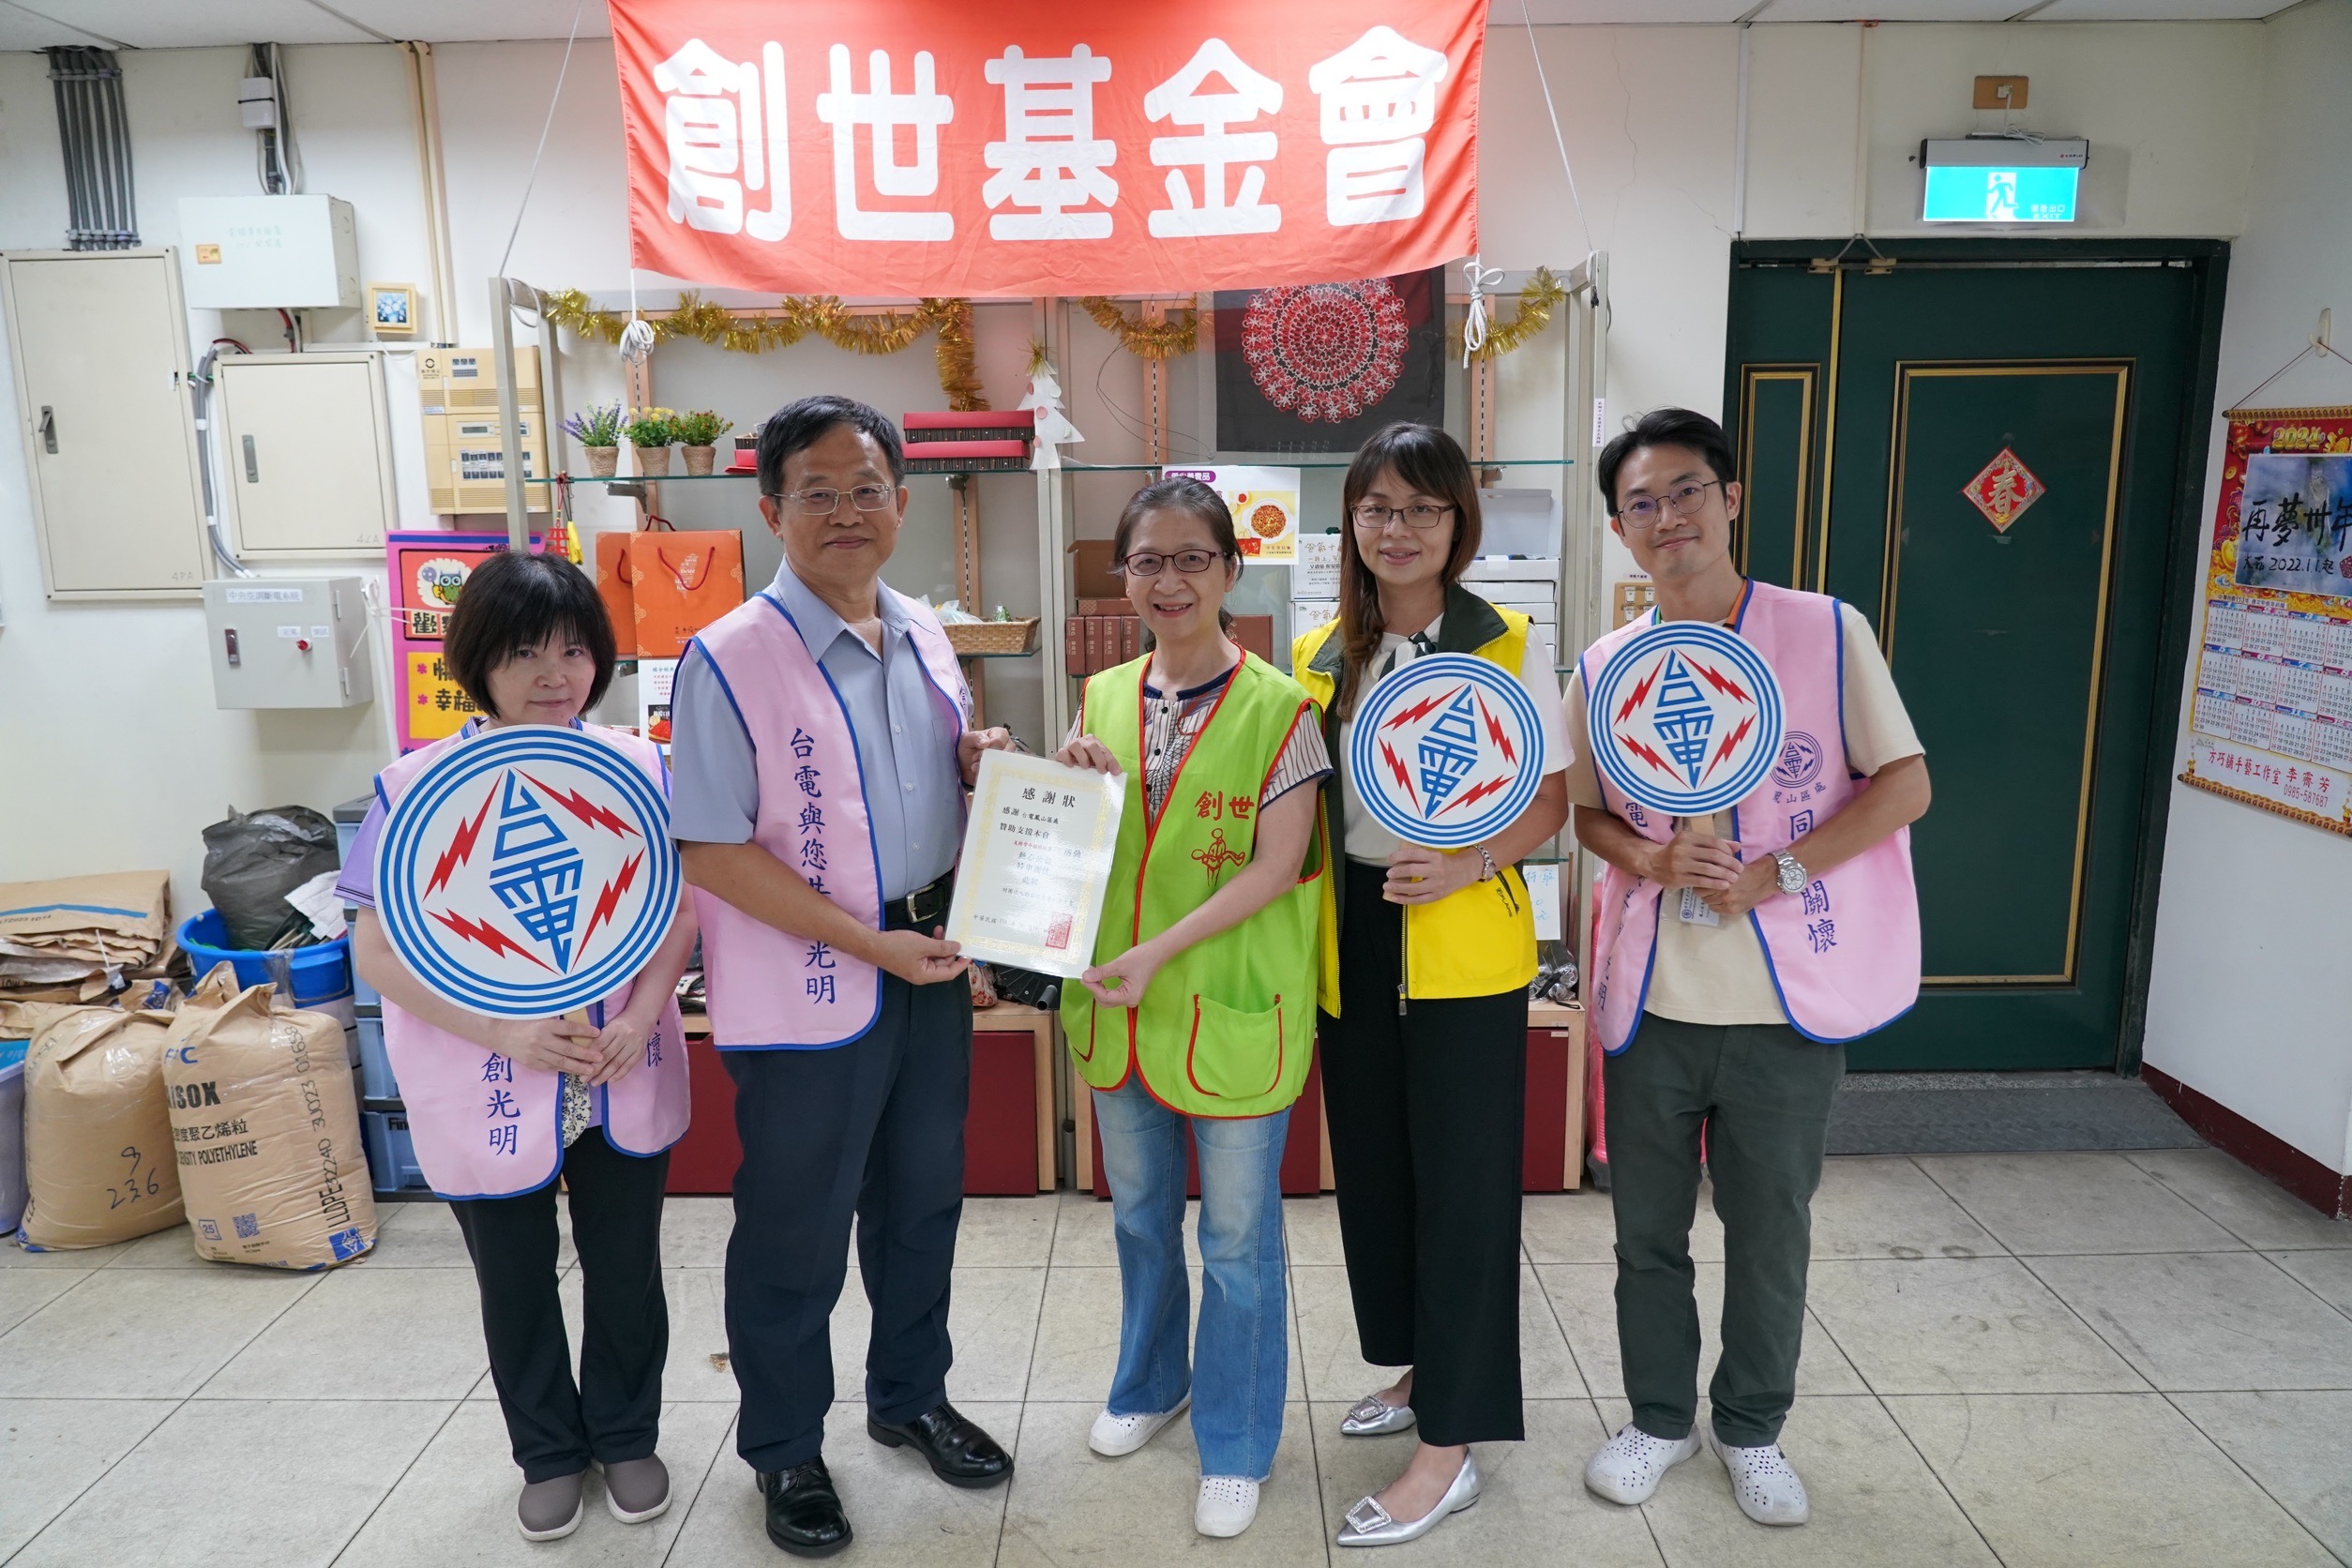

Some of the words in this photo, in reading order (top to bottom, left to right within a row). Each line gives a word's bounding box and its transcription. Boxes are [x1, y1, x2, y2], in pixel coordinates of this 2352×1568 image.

[654, 25, 1449, 242] 創世基金會
[2272, 427, 2321, 450] 2024
[1986, 469, 2027, 513] 春
[436, 688, 482, 712] 幸福
[1022, 787, 1075, 807] 感謝狀
[1194, 791, 1255, 821] 創世
[790, 728, 837, 1004] 台電與您共光明
[1790, 809, 1838, 954] 同關懷
[481, 1052, 521, 1156] 創光明
[173, 1119, 249, 1143] 密度聚乙烯粒
[388, 1117, 409, 1131] Fin
[198, 1140, 258, 1166] POLYETHYLENE
[203, 1224, 215, 1234] 25
